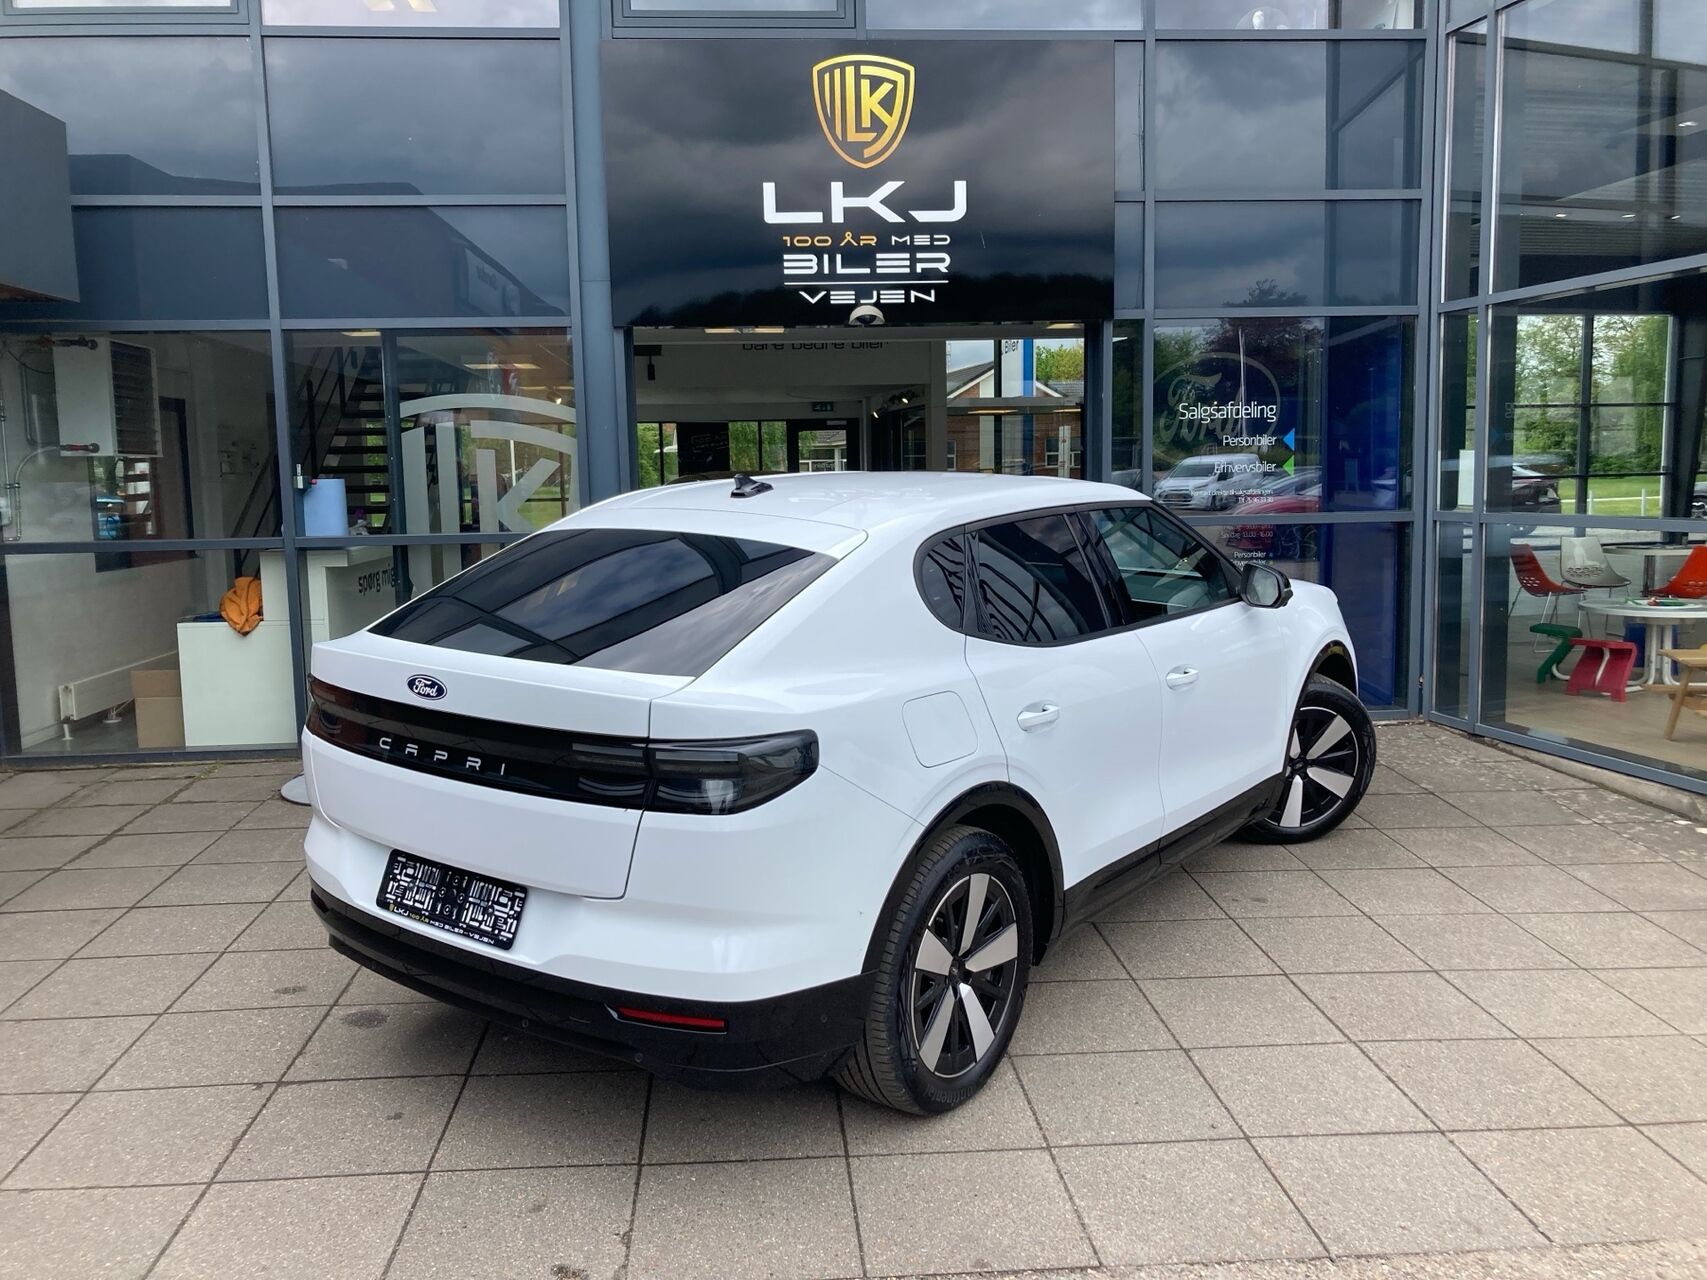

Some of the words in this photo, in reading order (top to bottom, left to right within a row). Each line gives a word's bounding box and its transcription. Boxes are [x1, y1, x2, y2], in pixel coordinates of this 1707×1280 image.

[762, 180, 968, 224] LKJ
[783, 235, 832, 247] 100
[840, 231, 878, 246] ÅR
[891, 234, 951, 246] MED
[783, 252, 951, 275] BILER
[799, 289, 936, 305] VEJEN
[1178, 401, 1277, 424] Salgsafdeling
[1222, 434, 1277, 447] Personbiler
[1214, 461, 1277, 473] Erhvervsbiler
[412, 677, 439, 697] Ford
[379, 737, 506, 776] CAPRI
[393, 906, 409, 916] LKJ
